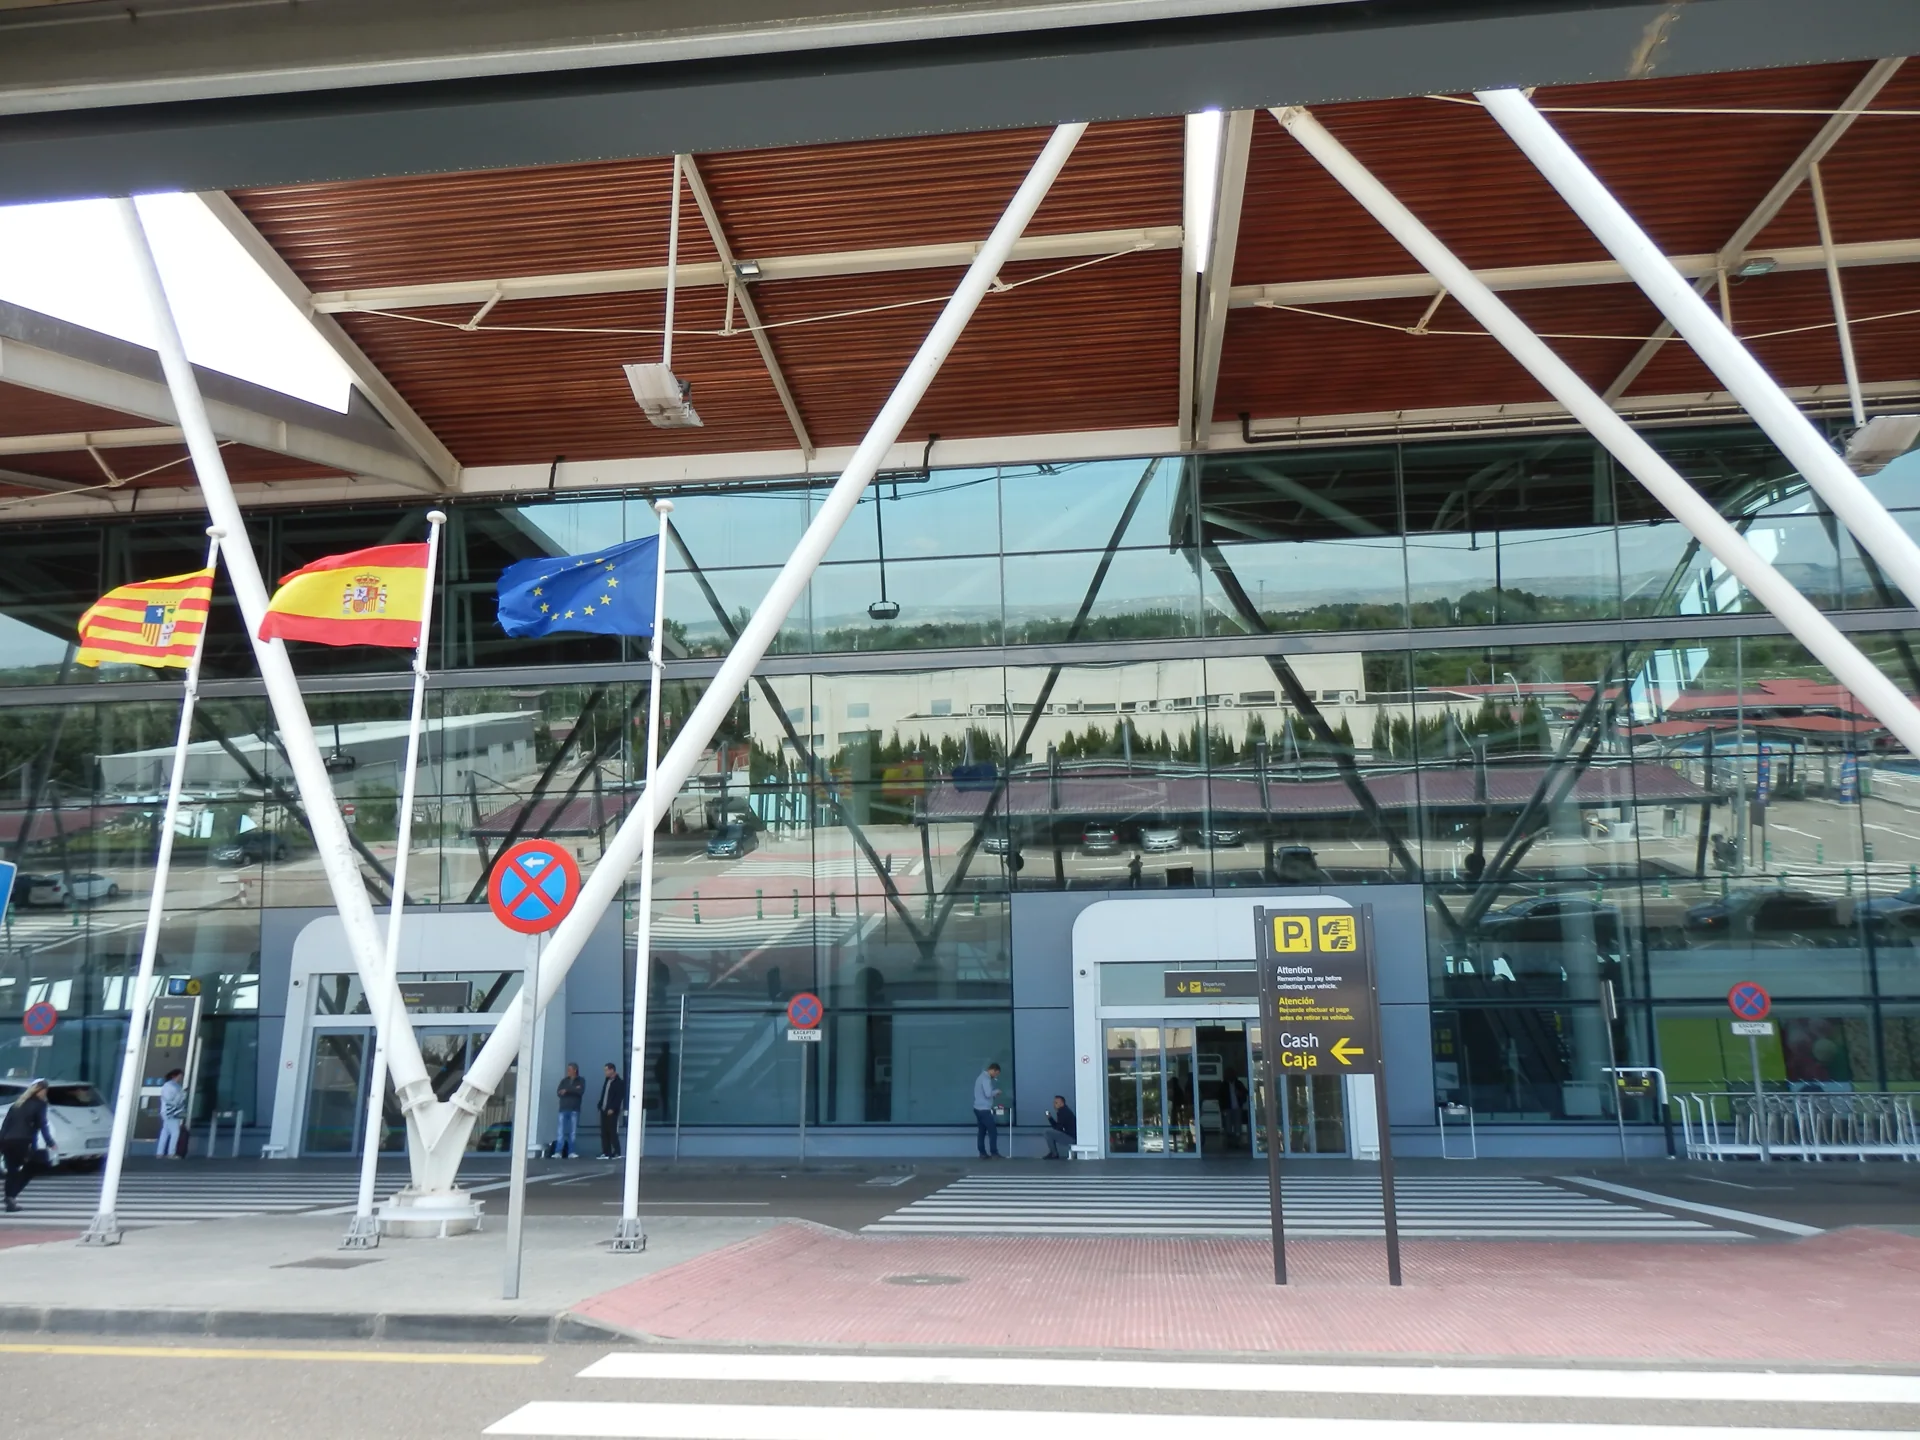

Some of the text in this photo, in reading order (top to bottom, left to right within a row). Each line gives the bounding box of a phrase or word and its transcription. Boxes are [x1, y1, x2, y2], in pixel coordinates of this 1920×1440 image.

[1276, 966, 1313, 974] Attention
[1277, 983, 1303, 991] collecting
[1279, 996, 1315, 1005] Atención
[1280, 1032, 1319, 1048] Cash
[1281, 1051, 1317, 1069] Caja
